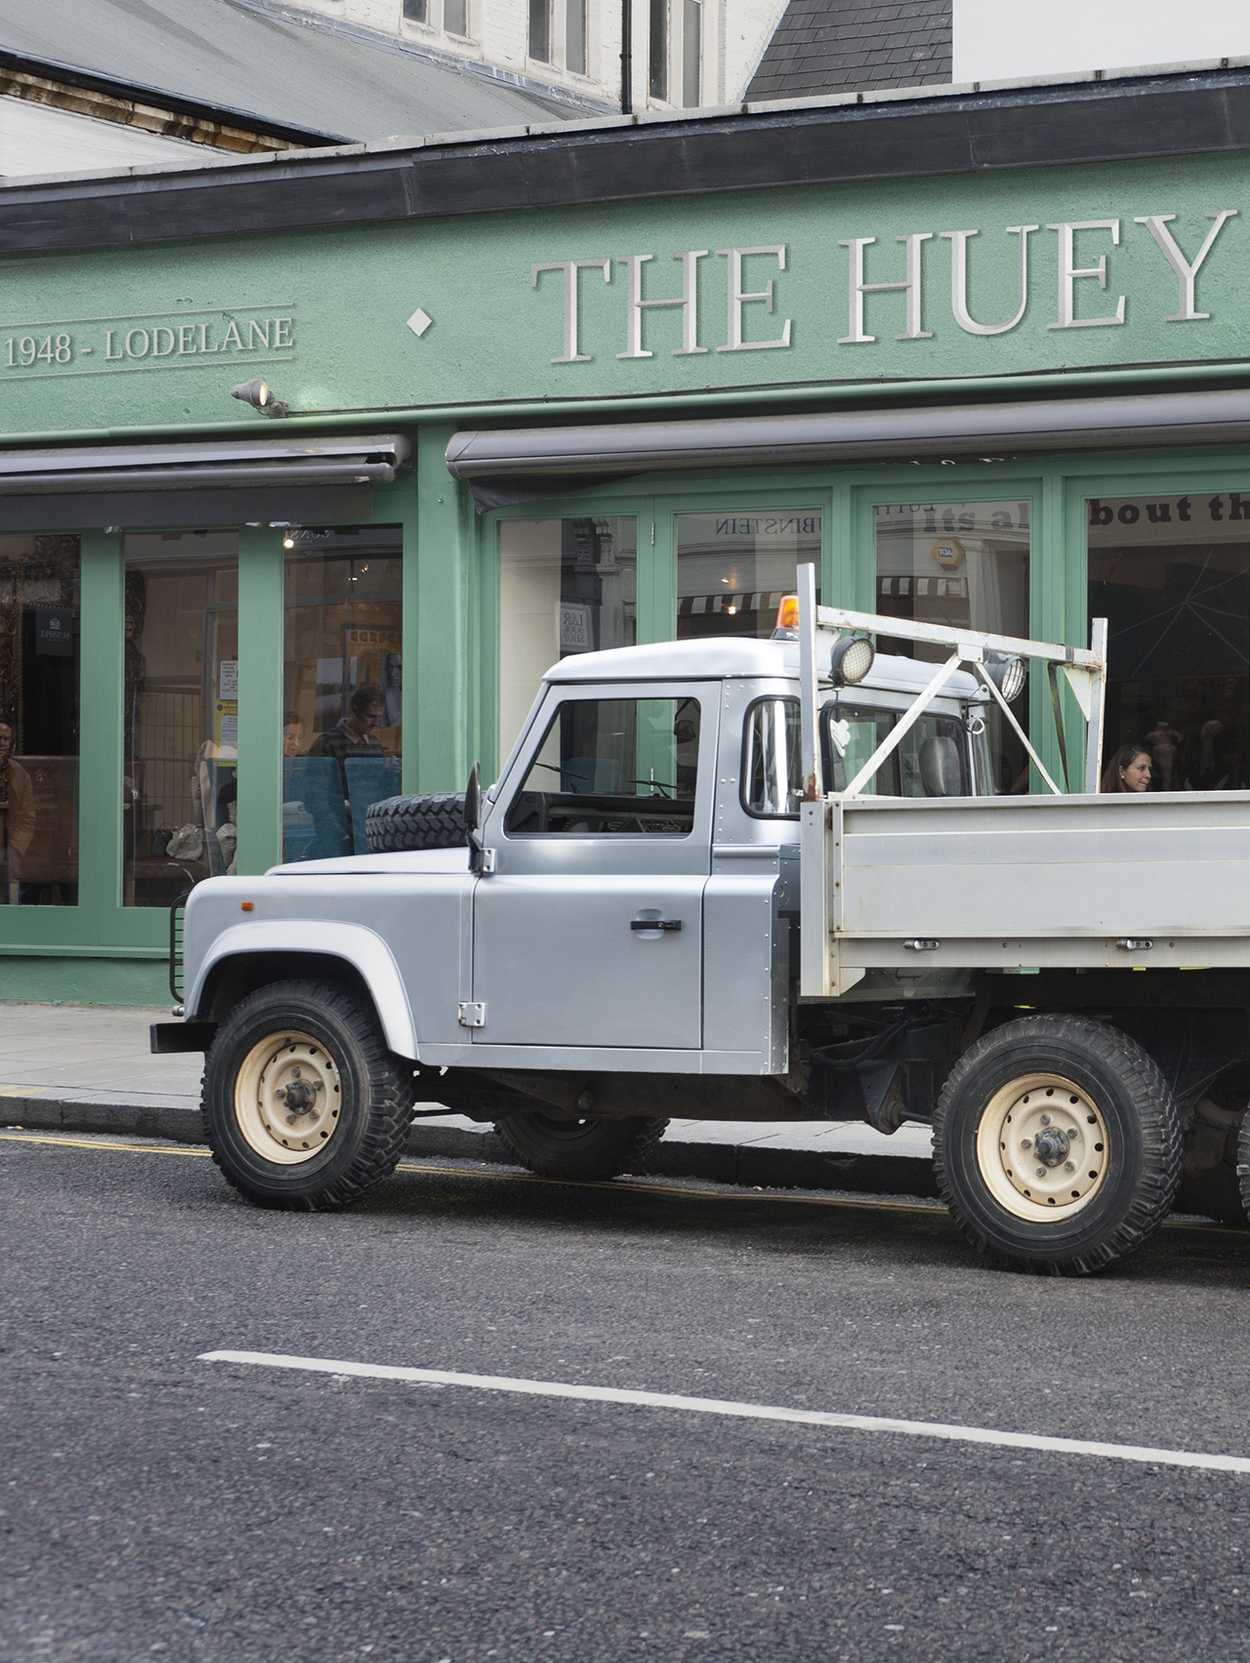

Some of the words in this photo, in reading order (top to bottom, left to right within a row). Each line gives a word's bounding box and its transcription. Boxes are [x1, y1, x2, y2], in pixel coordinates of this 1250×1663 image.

[531, 244, 792, 363] THE
[837, 209, 1239, 345] HUEY
[4, 332, 72, 367] 1948
[104, 317, 294, 360] LODELANE
[991, 502, 1030, 530] al
[1089, 495, 1191, 526] bout
[1208, 493, 1250, 521] th
